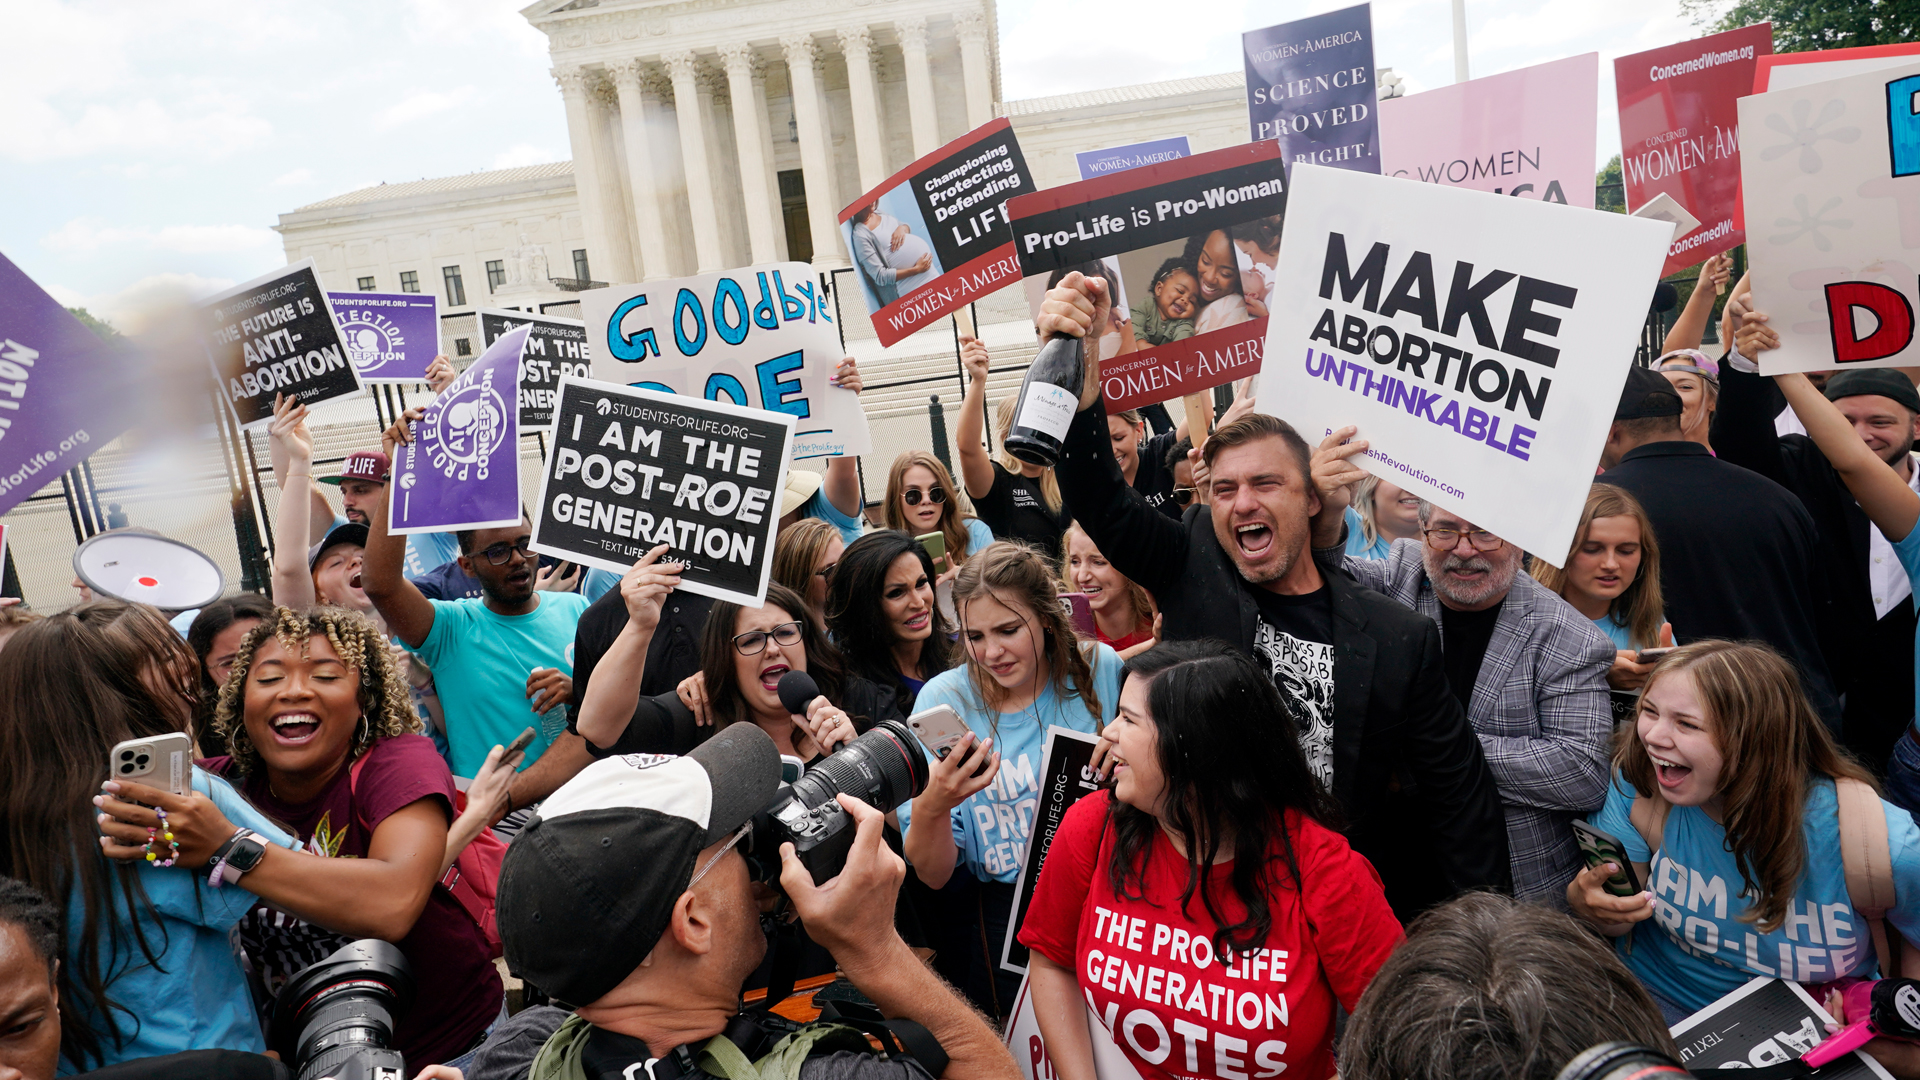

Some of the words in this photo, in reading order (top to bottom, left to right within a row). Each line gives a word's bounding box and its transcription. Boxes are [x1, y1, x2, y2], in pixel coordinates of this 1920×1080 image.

[1252, 44, 1299, 64] WOMEN
[1305, 30, 1362, 53] AMERICA
[1650, 45, 1754, 82] ConcernedWomen.org
[1254, 66, 1366, 105] SCIENCE
[1257, 103, 1368, 140] PROVED
[1646, 127, 1688, 148] CONCERNED
[924, 144, 1008, 192] Championing
[929, 157, 1014, 207] Protecting
[1089, 158, 1131, 173] WOMEN
[1135, 150, 1182, 166] AMERICA
[1418, 147, 1540, 184] WOMEN
[1626, 135, 1706, 187] WOMEN
[934, 173, 1021, 223] Defending
[1023, 214, 1125, 254] Pro-Life
[1131, 206, 1151, 228] is
[1155, 178, 1283, 222] Pro-Woman
[214, 324, 241, 346] THE
[241, 303, 297, 337] FUTURE
[298, 297, 315, 316] IS
[223, 282, 297, 316] STUDENTSFORLIFE.ORG
[888, 286, 953, 332] WOMEN
[900, 288, 933, 309] CONCERNED
[1318, 231, 1578, 369] MAKE
[242, 327, 302, 367] ANTI-
[553, 339, 590, 359] THE
[1102, 356, 1157, 377] CONCERNED
[1309, 308, 1552, 422] ABORTION
[230, 343, 345, 402] ABORTION
[302, 387, 319, 399] 53445
[1099, 361, 1183, 401] OMEN
[1185, 364, 1195, 375] for
[477, 368, 494, 480] CONCEPTION
[613, 402, 749, 440] STUDENTSFORLIFE.ORG
[1305, 347, 1537, 463] UNTHINKABLE
[449, 428, 465, 452] AT
[572, 413, 583, 441] I
[599, 421, 663, 458] AM
[682, 435, 762, 478] THE
[554, 446, 772, 525] POST-ROE
[552, 492, 756, 566] GENERATION
[600, 539, 621, 554] TEXT
[624, 545, 643, 559] LIFE
[1656, 856, 1728, 920] AM
[1748, 889, 1856, 946] HE
[1095, 905, 1146, 953] THE
[1152, 923, 1289, 983] PRO-LIFE
[1086, 949, 1289, 1031] GENERATION
[1085, 987, 1288, 1080] VOTES
[1697, 1031, 1724, 1055] TEXT
